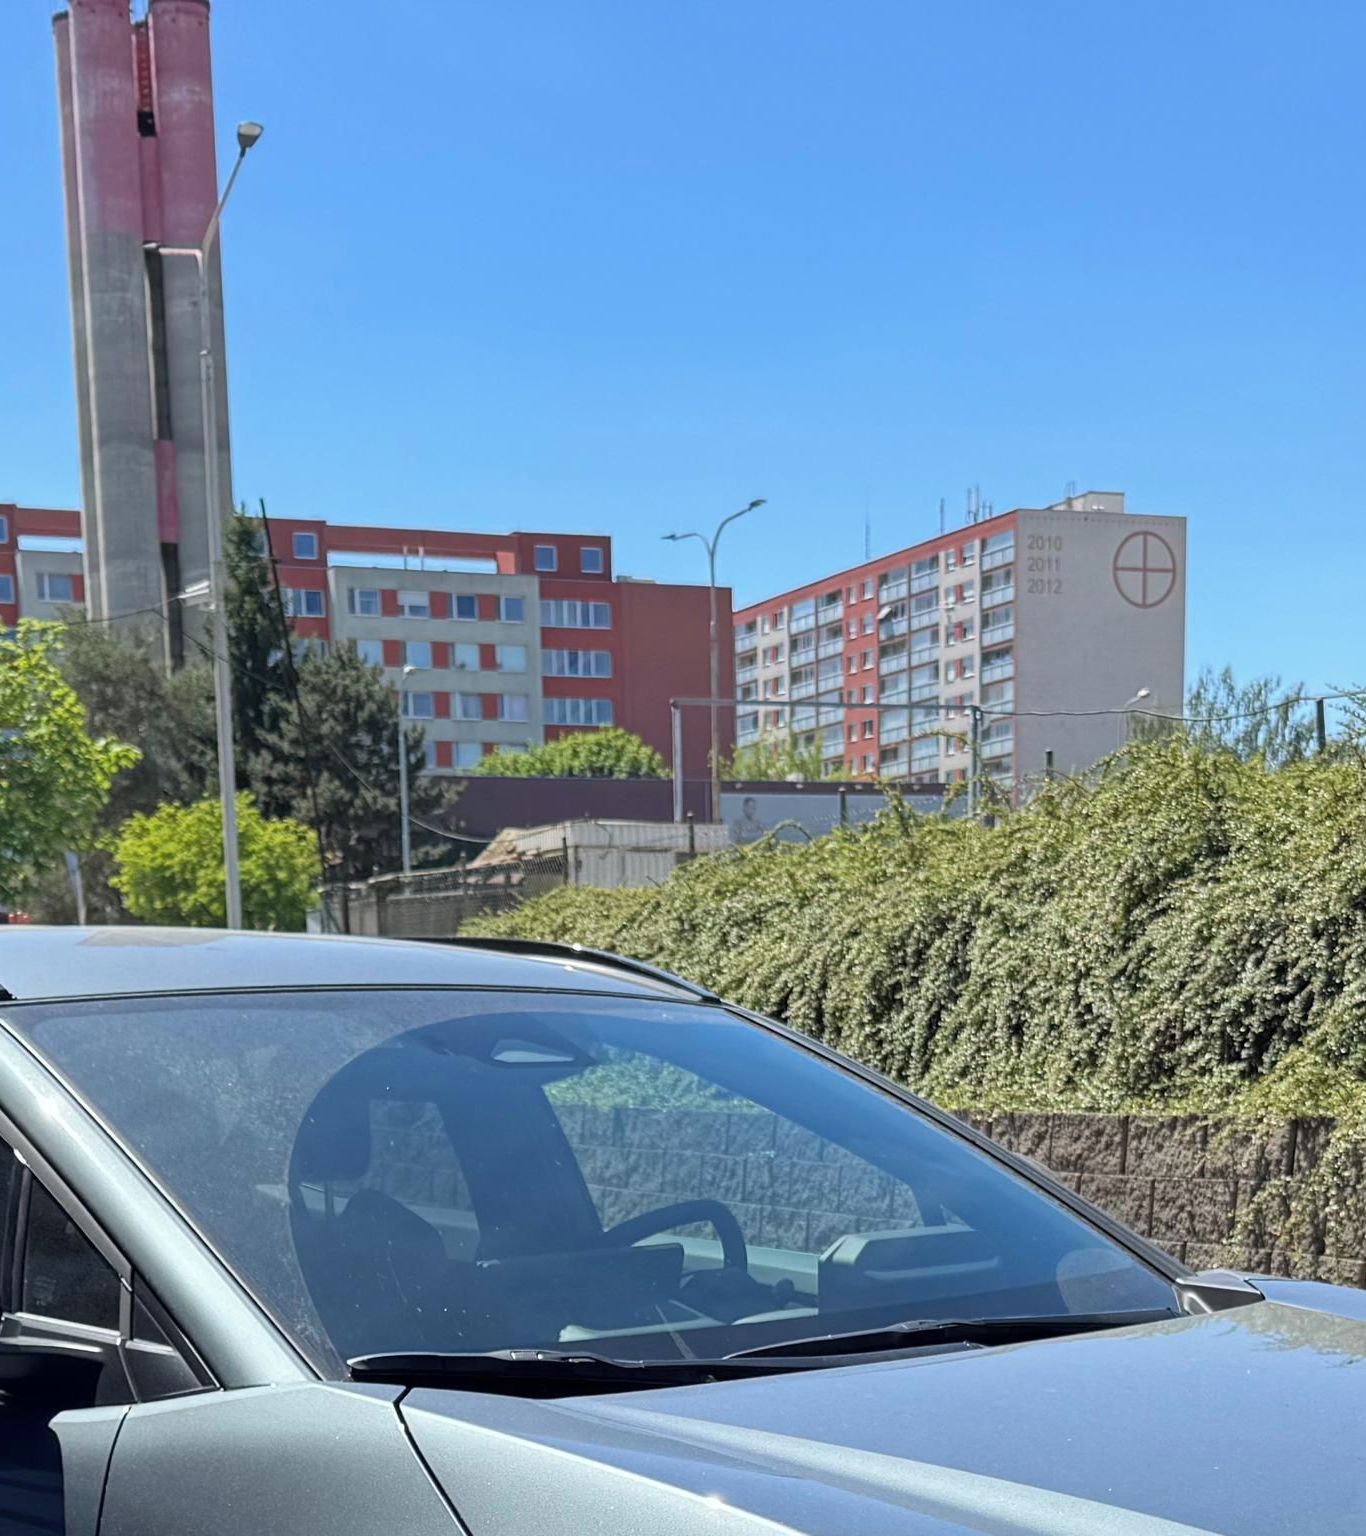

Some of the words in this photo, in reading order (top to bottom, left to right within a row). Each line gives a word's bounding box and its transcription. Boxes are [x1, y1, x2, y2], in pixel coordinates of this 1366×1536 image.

[1027, 534, 1063, 552] 2010
[1027, 556, 1061, 573] 2011
[1027, 578, 1063, 594] 2012
